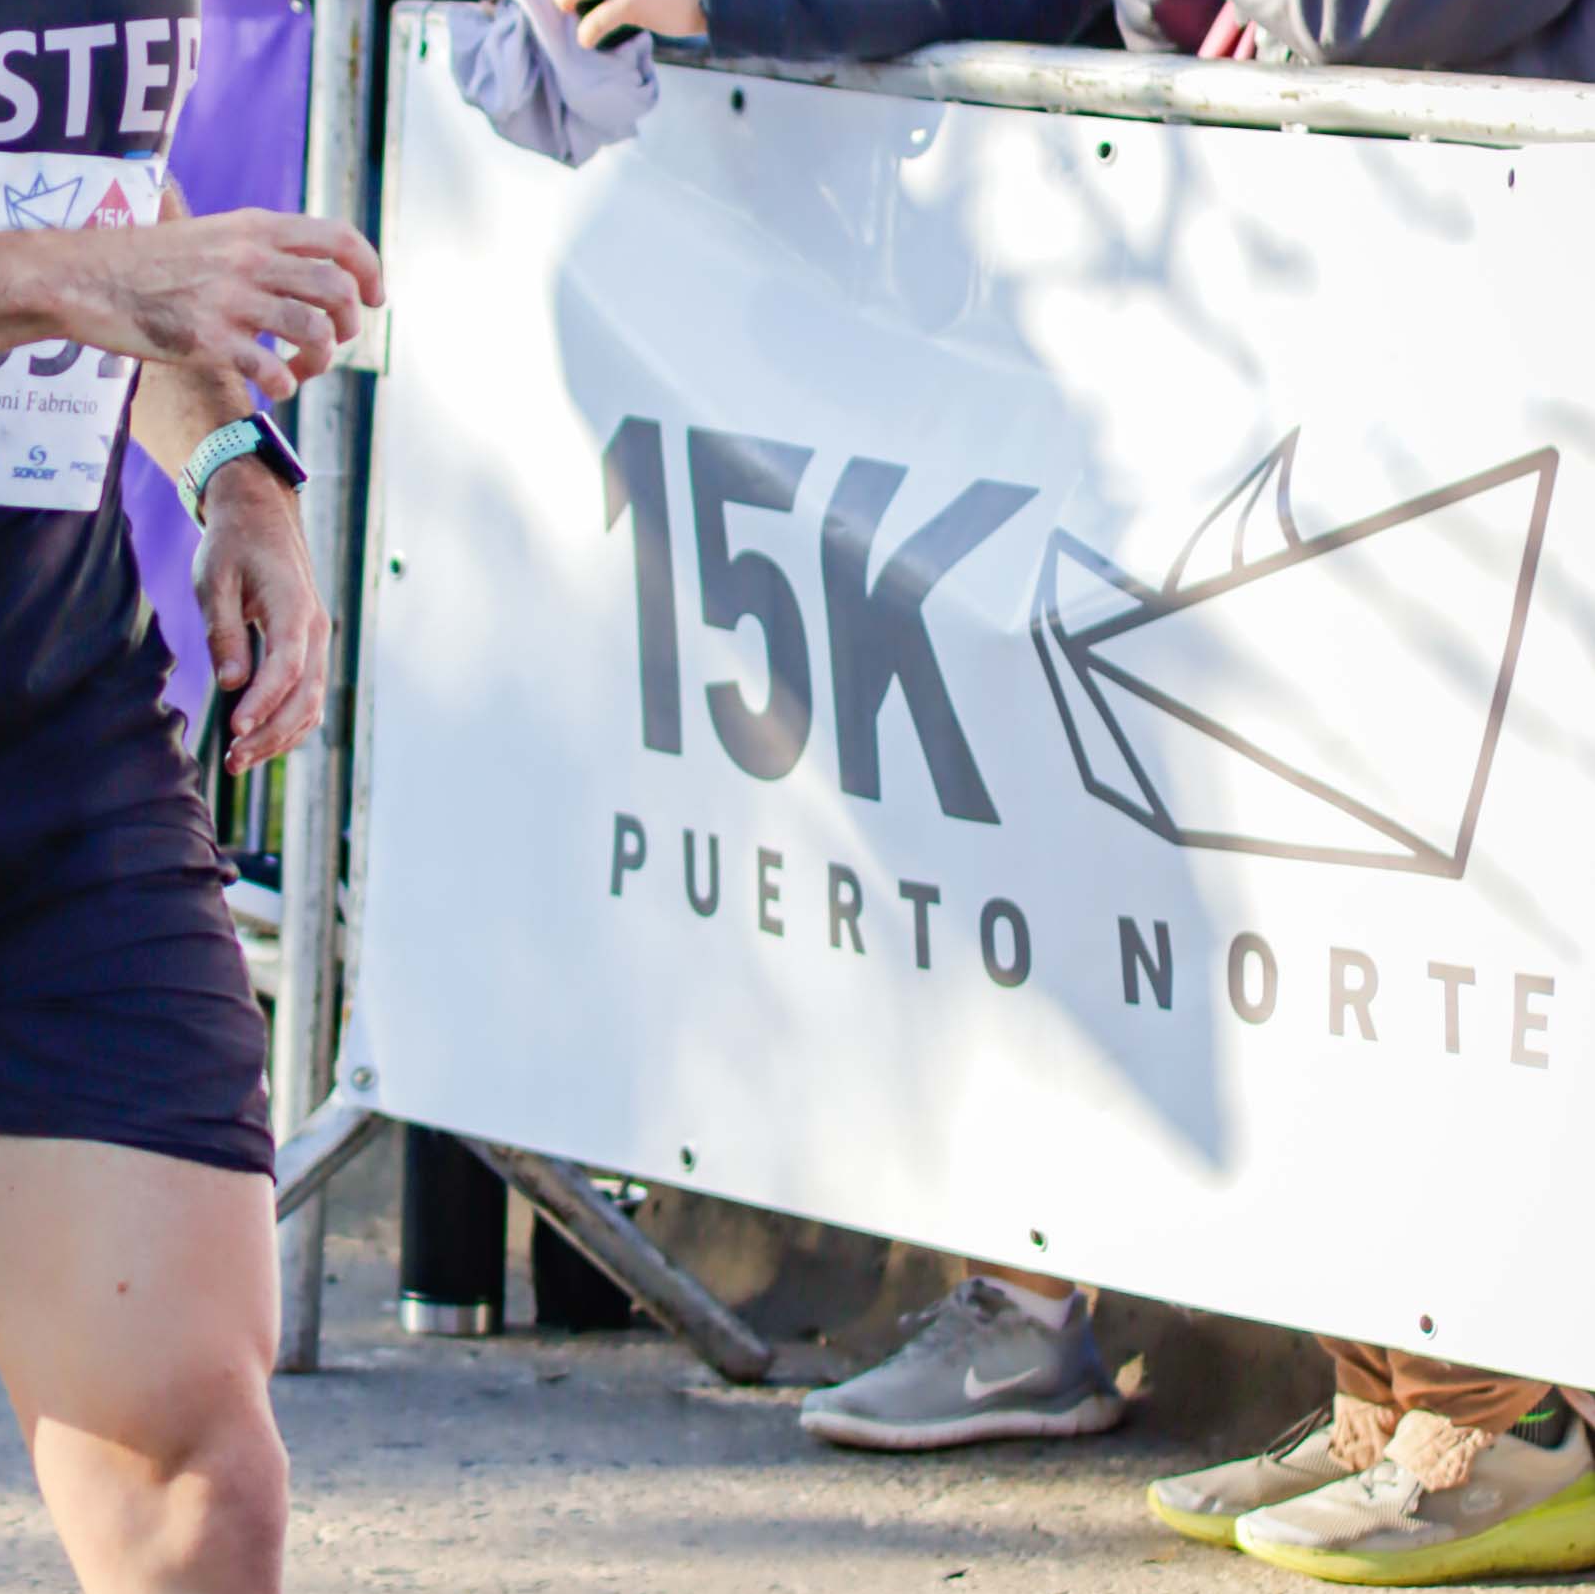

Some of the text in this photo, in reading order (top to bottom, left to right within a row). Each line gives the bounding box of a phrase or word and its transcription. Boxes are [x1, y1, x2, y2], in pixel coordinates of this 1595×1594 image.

[26, 389, 98, 415] Fabricio
[601, 415, 1042, 825] 15K
[609, 810, 1557, 1070] PUERTO NORTE
